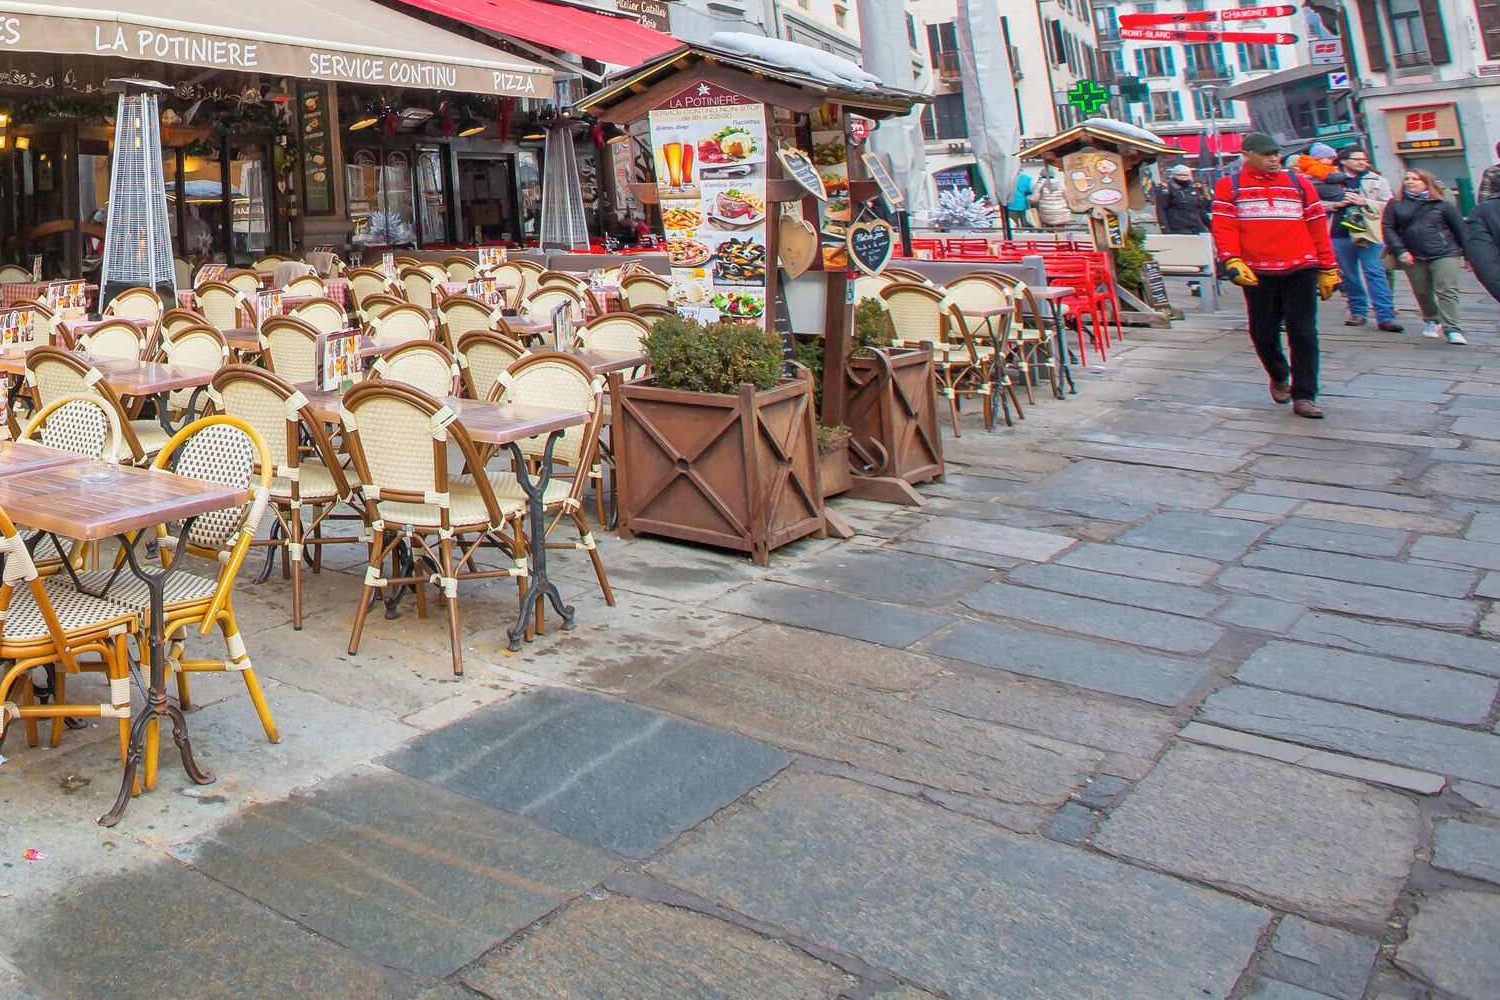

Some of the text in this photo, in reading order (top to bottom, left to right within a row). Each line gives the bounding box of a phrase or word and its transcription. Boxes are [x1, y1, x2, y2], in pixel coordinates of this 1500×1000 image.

[1222, 8, 1268, 19] CHAMONIX
[1120, 29, 1171, 39] MONT-BLANC
[94, 25, 258, 68] LA POTINIERE
[309, 53, 457, 88] SERVICE CONTINU
[493, 71, 535, 94] PIZZA
[669, 99, 682, 109] LA
[719, 104, 762, 113] NON-STOP
